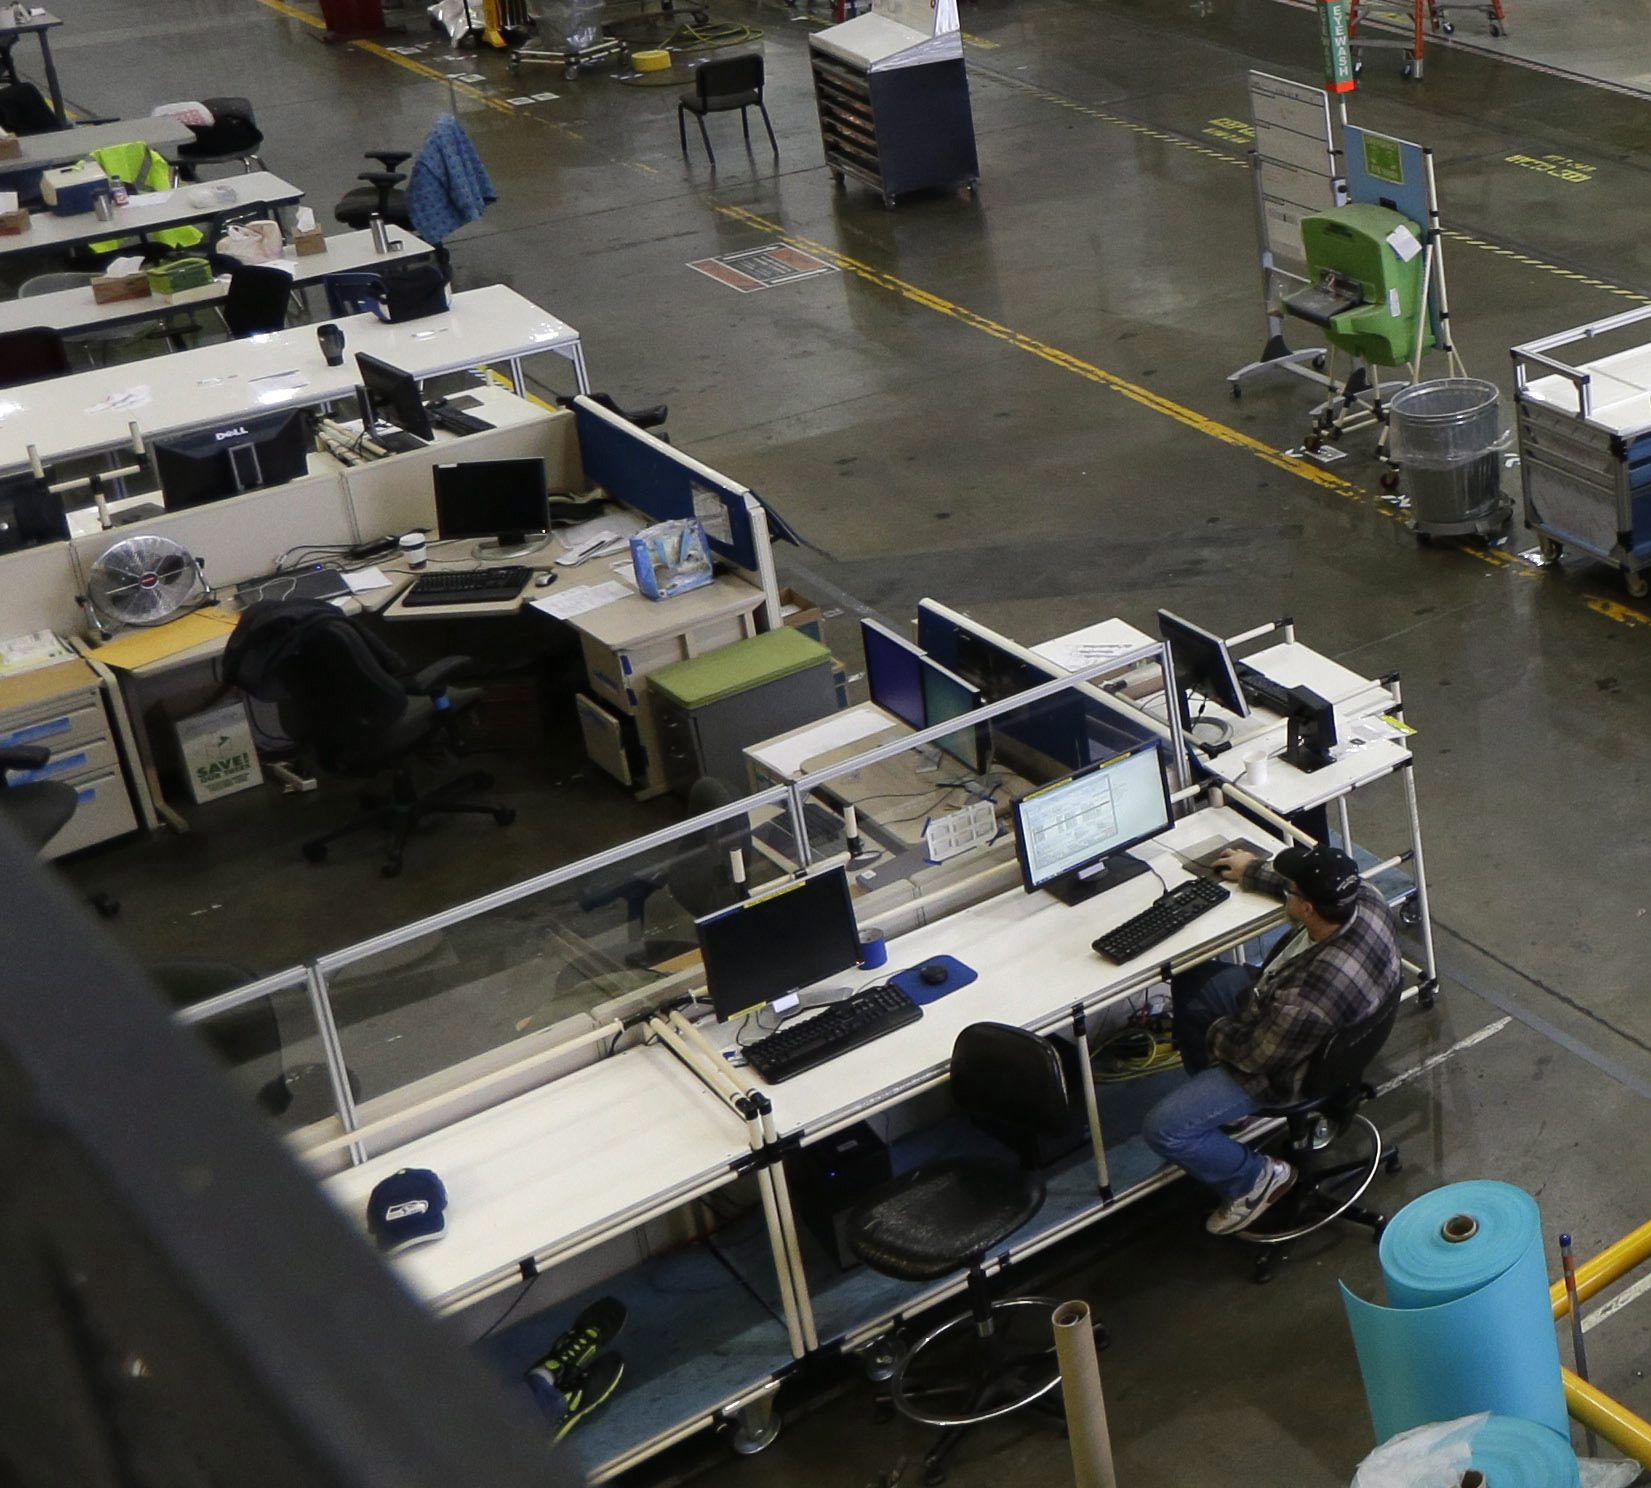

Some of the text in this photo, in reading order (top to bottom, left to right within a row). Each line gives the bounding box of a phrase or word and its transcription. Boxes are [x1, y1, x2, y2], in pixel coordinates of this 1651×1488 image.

[1332, 3, 1349, 77] EYEWASH
[215, 426, 249, 441] DELL
[197, 752, 251, 778] SAVE!
